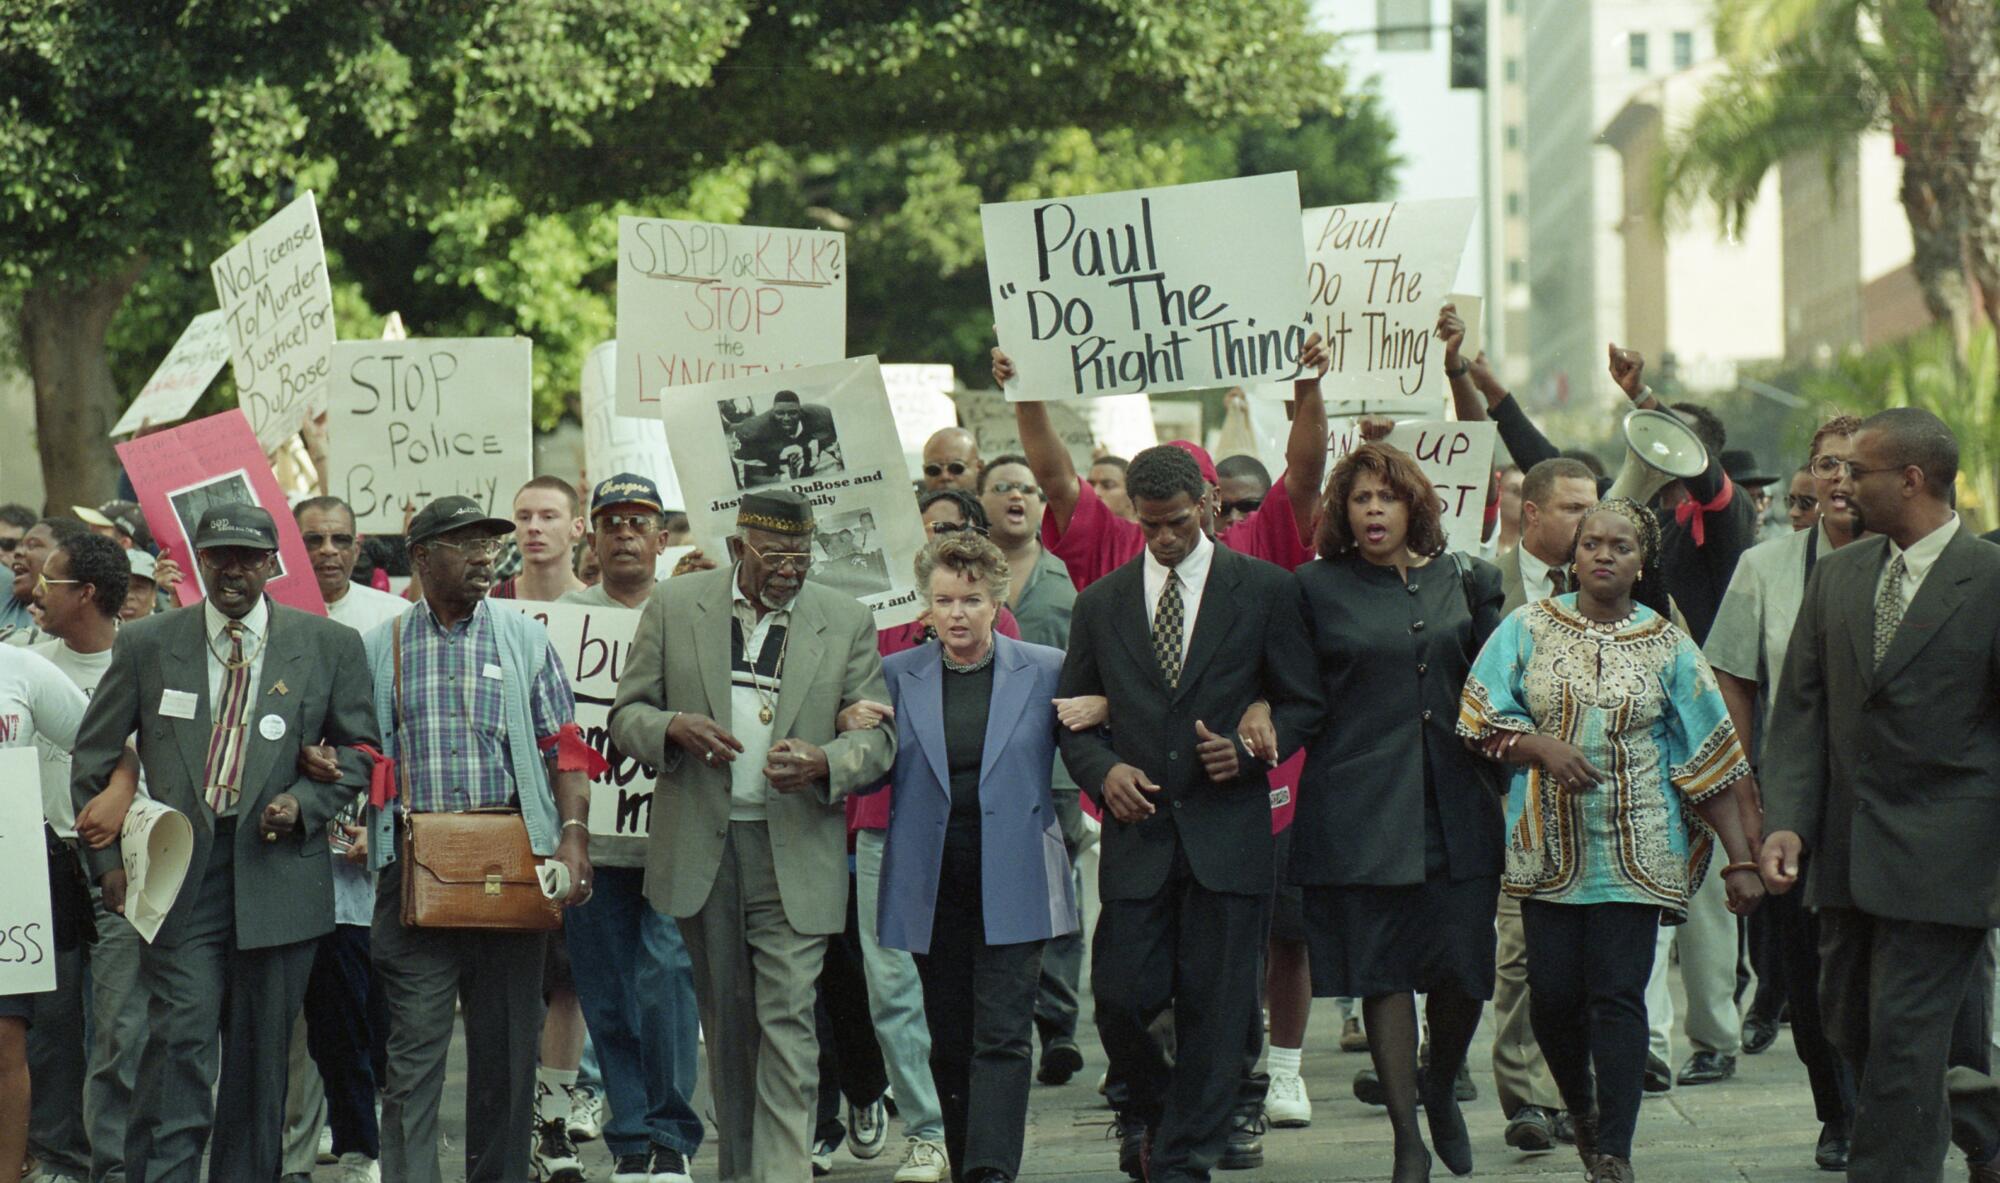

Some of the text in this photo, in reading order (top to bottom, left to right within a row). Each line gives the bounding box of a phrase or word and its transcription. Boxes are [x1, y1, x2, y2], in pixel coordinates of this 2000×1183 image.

[628, 222, 728, 276] SDPD
[1033, 197, 1158, 281] Paul
[1316, 202, 1397, 252] Paul
[217, 222, 316, 301] No License
[1364, 254, 1422, 304] The
[227, 261, 323, 348] To Murder
[684, 282, 783, 335] STOP
[1109, 271, 1229, 331] The
[236, 325, 302, 394] Justice
[298, 296, 331, 346] For
[714, 334, 745, 357] the
[1071, 331, 1191, 395] Right
[350, 352, 458, 414] STOP
[1416, 431, 1470, 467] UP
[601, 481, 651, 497] Chargers
[710, 495, 742, 512] Just
[791, 471, 882, 494] DuBose and
[869, 591, 916, 612] ez and
